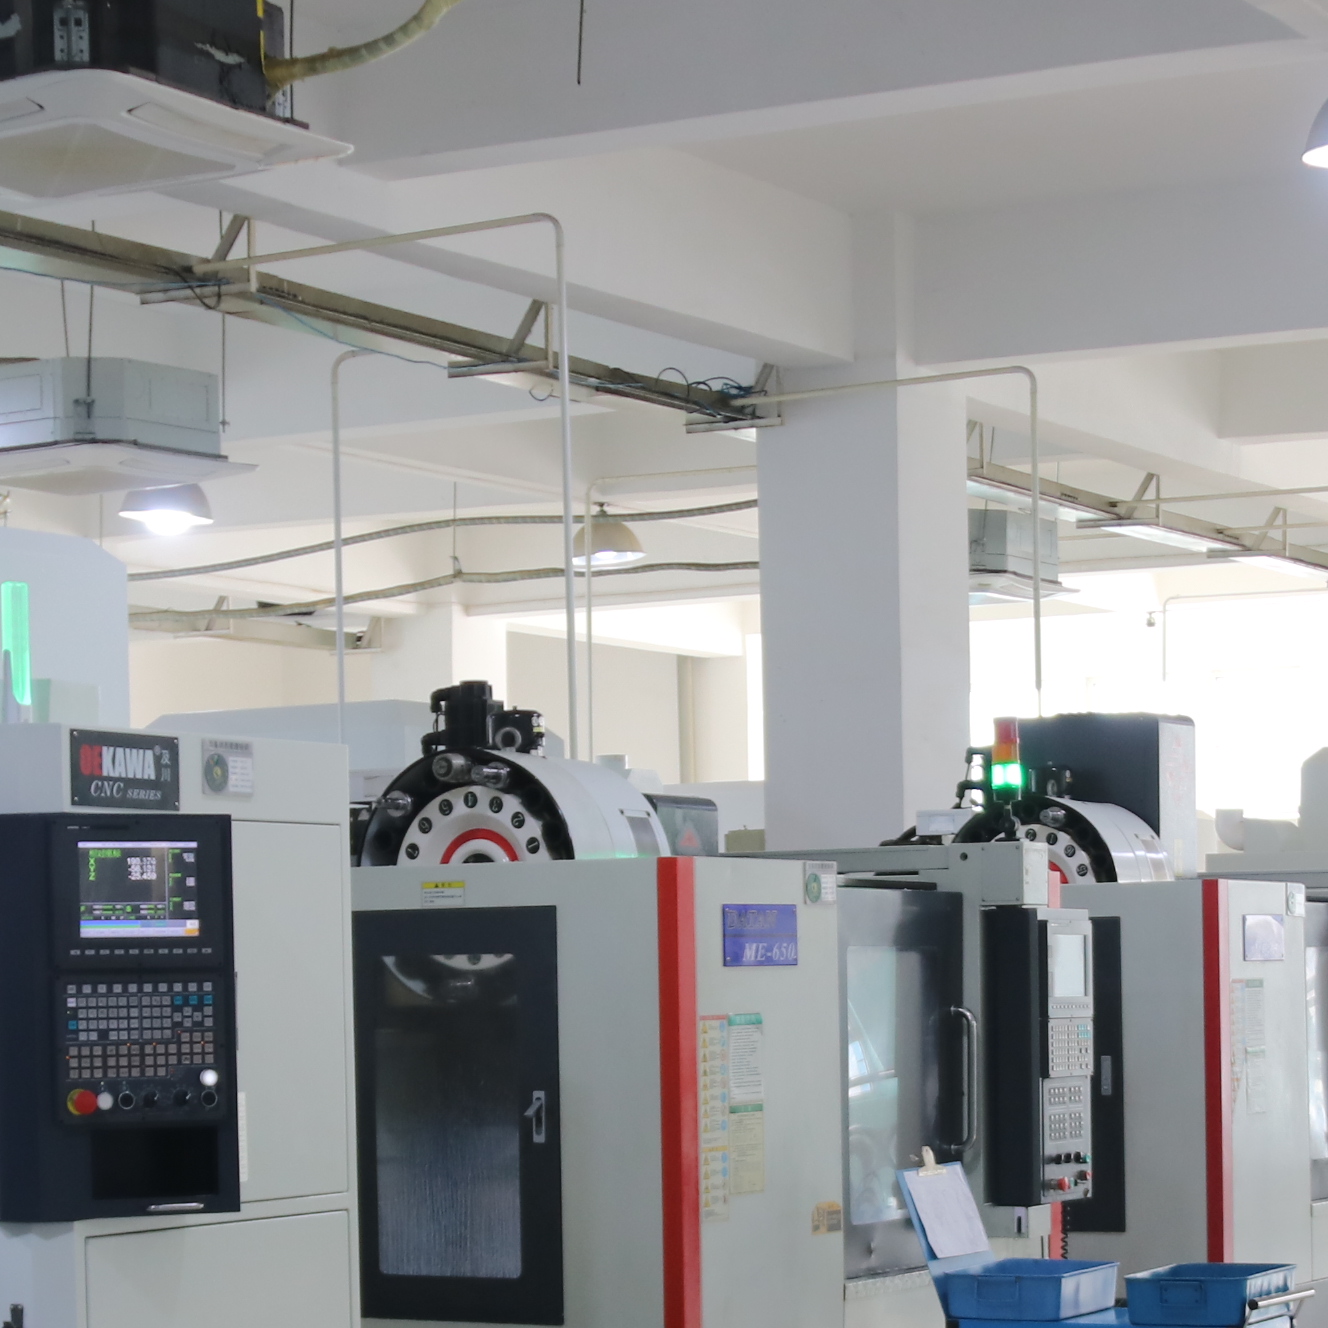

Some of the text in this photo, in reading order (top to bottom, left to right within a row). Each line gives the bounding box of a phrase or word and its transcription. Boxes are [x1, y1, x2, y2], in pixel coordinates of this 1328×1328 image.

[79, 744, 156, 780] OEKAWA
[90, 780, 162, 800] CNC SERIES
[743, 942, 796, 961] ME-650
